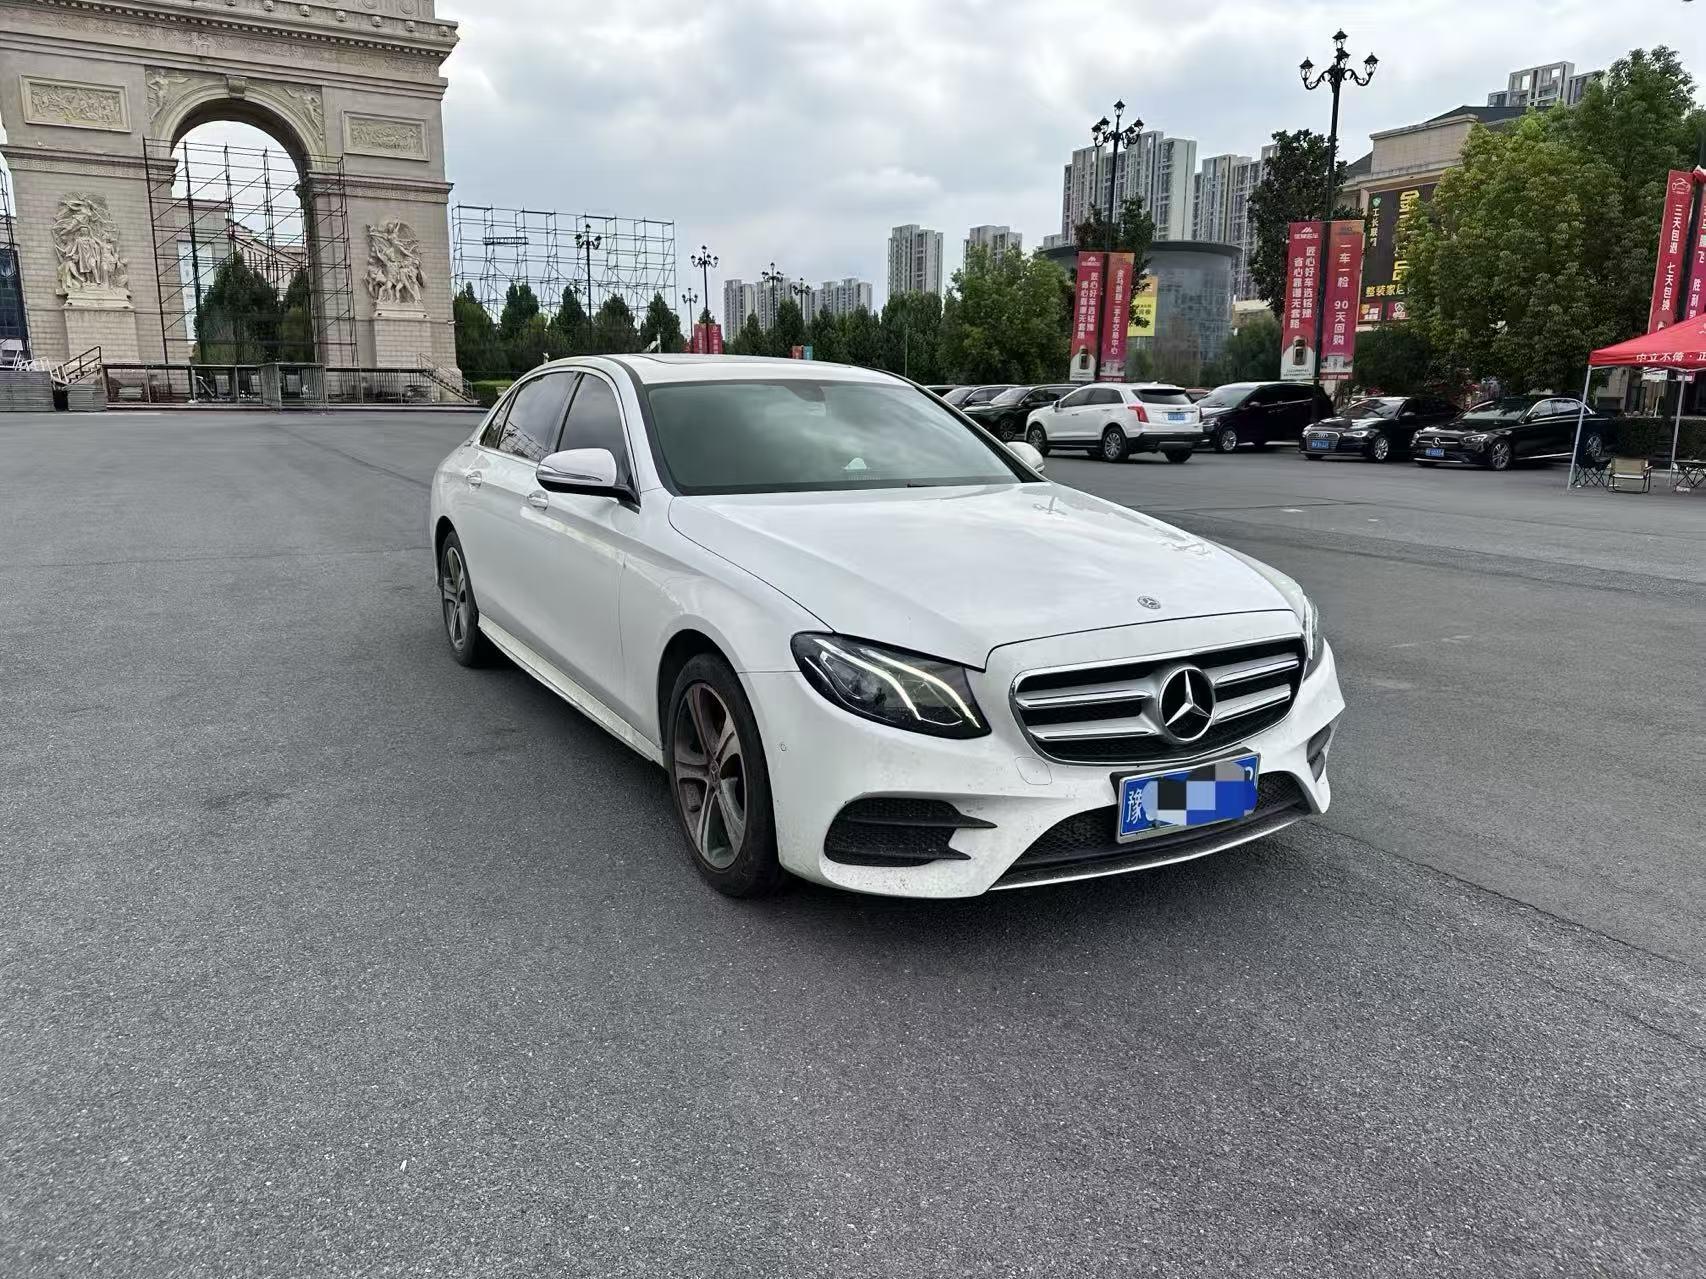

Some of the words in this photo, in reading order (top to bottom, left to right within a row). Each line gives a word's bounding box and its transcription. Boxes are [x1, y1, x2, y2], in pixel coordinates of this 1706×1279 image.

[1669, 204, 1683, 254] 三天包退
[1337, 244, 1352, 288] 一车一检
[1662, 262, 1675, 311] 七天包换
[1290, 257, 1303, 328] 省心靠谱无套路
[1333, 300, 1348, 345] 90天回购
